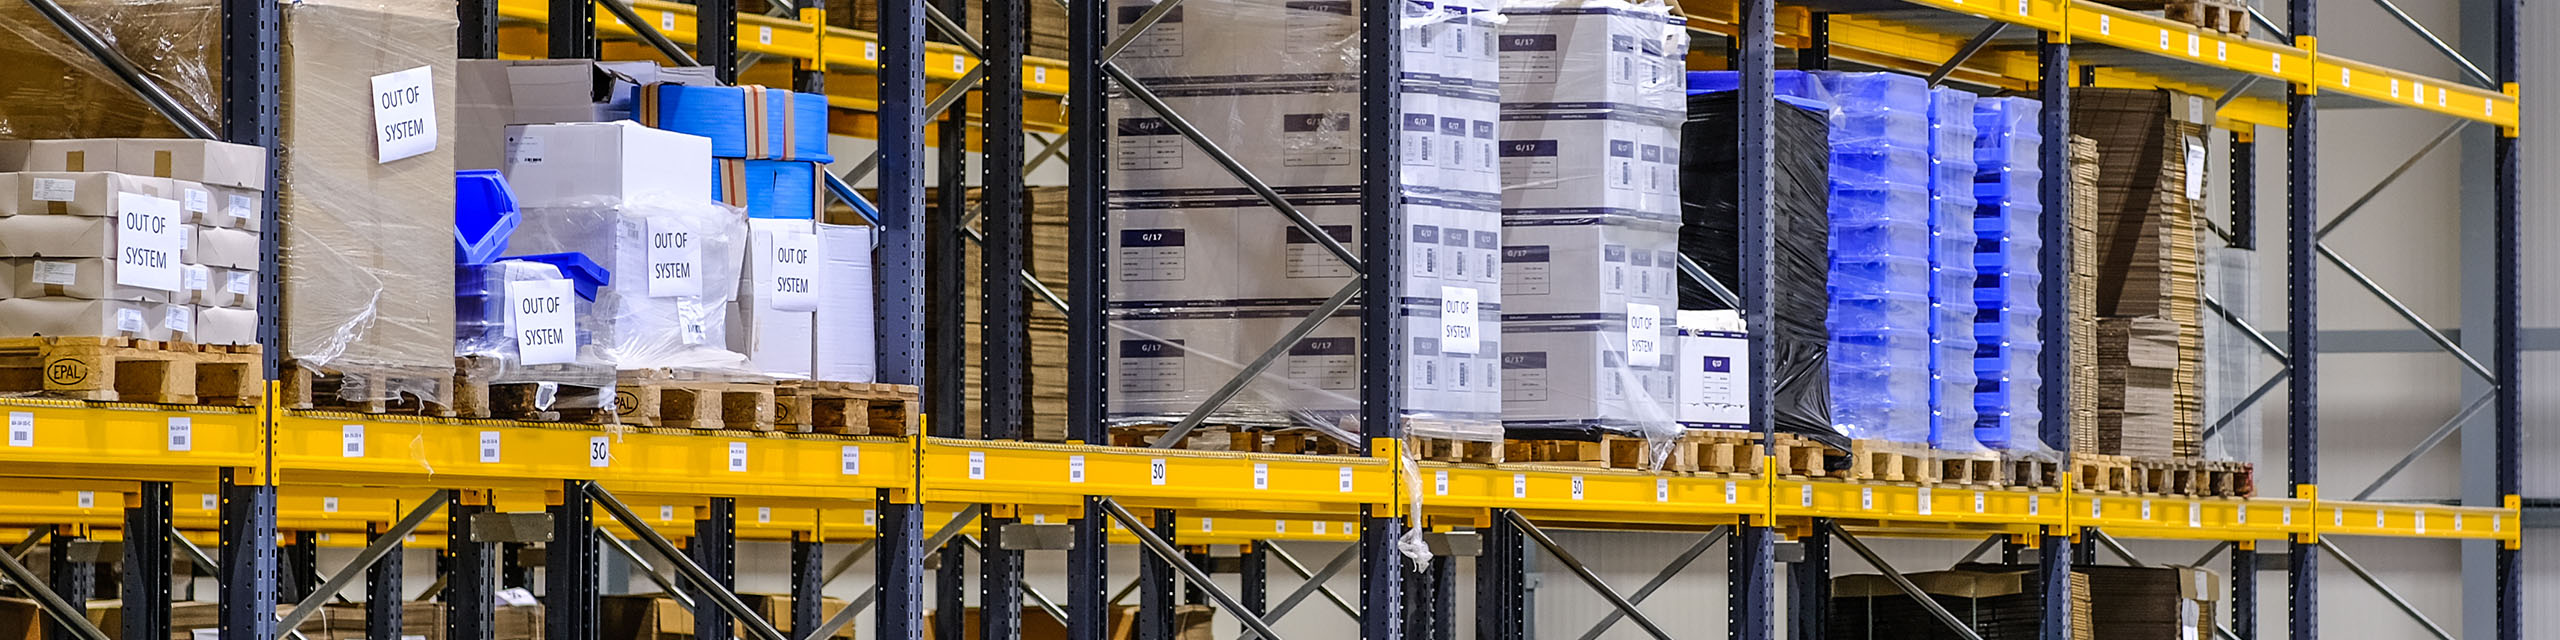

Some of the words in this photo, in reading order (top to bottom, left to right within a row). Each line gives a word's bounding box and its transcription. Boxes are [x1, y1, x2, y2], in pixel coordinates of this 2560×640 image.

[1514, 38, 1535, 46] G/17
[381, 89, 404, 109] OUT
[406, 85, 420, 104] OF
[384, 117, 424, 142] SYSTEM
[1139, 121, 1160, 130] G/17
[1515, 143, 1536, 152] G/17
[126, 212, 150, 232] OUT
[151, 216, 166, 234] OF
[654, 232, 673, 249] OUT
[674, 232, 688, 249] OF
[1142, 233, 1163, 242] G/17
[125, 246, 167, 269] SYSTEM
[777, 247, 795, 263] OUT
[796, 248, 808, 265] OF
[1507, 249, 1528, 258] G/17
[655, 262, 691, 279] SYSTEM
[777, 276, 809, 294] SYSTEM
[522, 297, 544, 315] OUT
[546, 296, 560, 314] OF
[1446, 299, 1460, 314] OUT
[1460, 301, 1470, 315] OF
[1631, 315, 1643, 329] OUT
[1644, 317, 1652, 330] OF
[525, 327, 564, 346] SYSTEM
[1446, 324, 1471, 339] SYSTEM
[1141, 343, 1162, 352] G/17
[1312, 341, 1332, 350] G/17
[1631, 339, 1653, 353] SYSTEM
[1504, 355, 1525, 364] G/17
[53, 364, 81, 379] EPAL
[614, 396, 633, 410] PAL
[592, 442, 607, 460] 30
[1152, 463, 1164, 479] 30
[1573, 480, 1583, 495] 30
